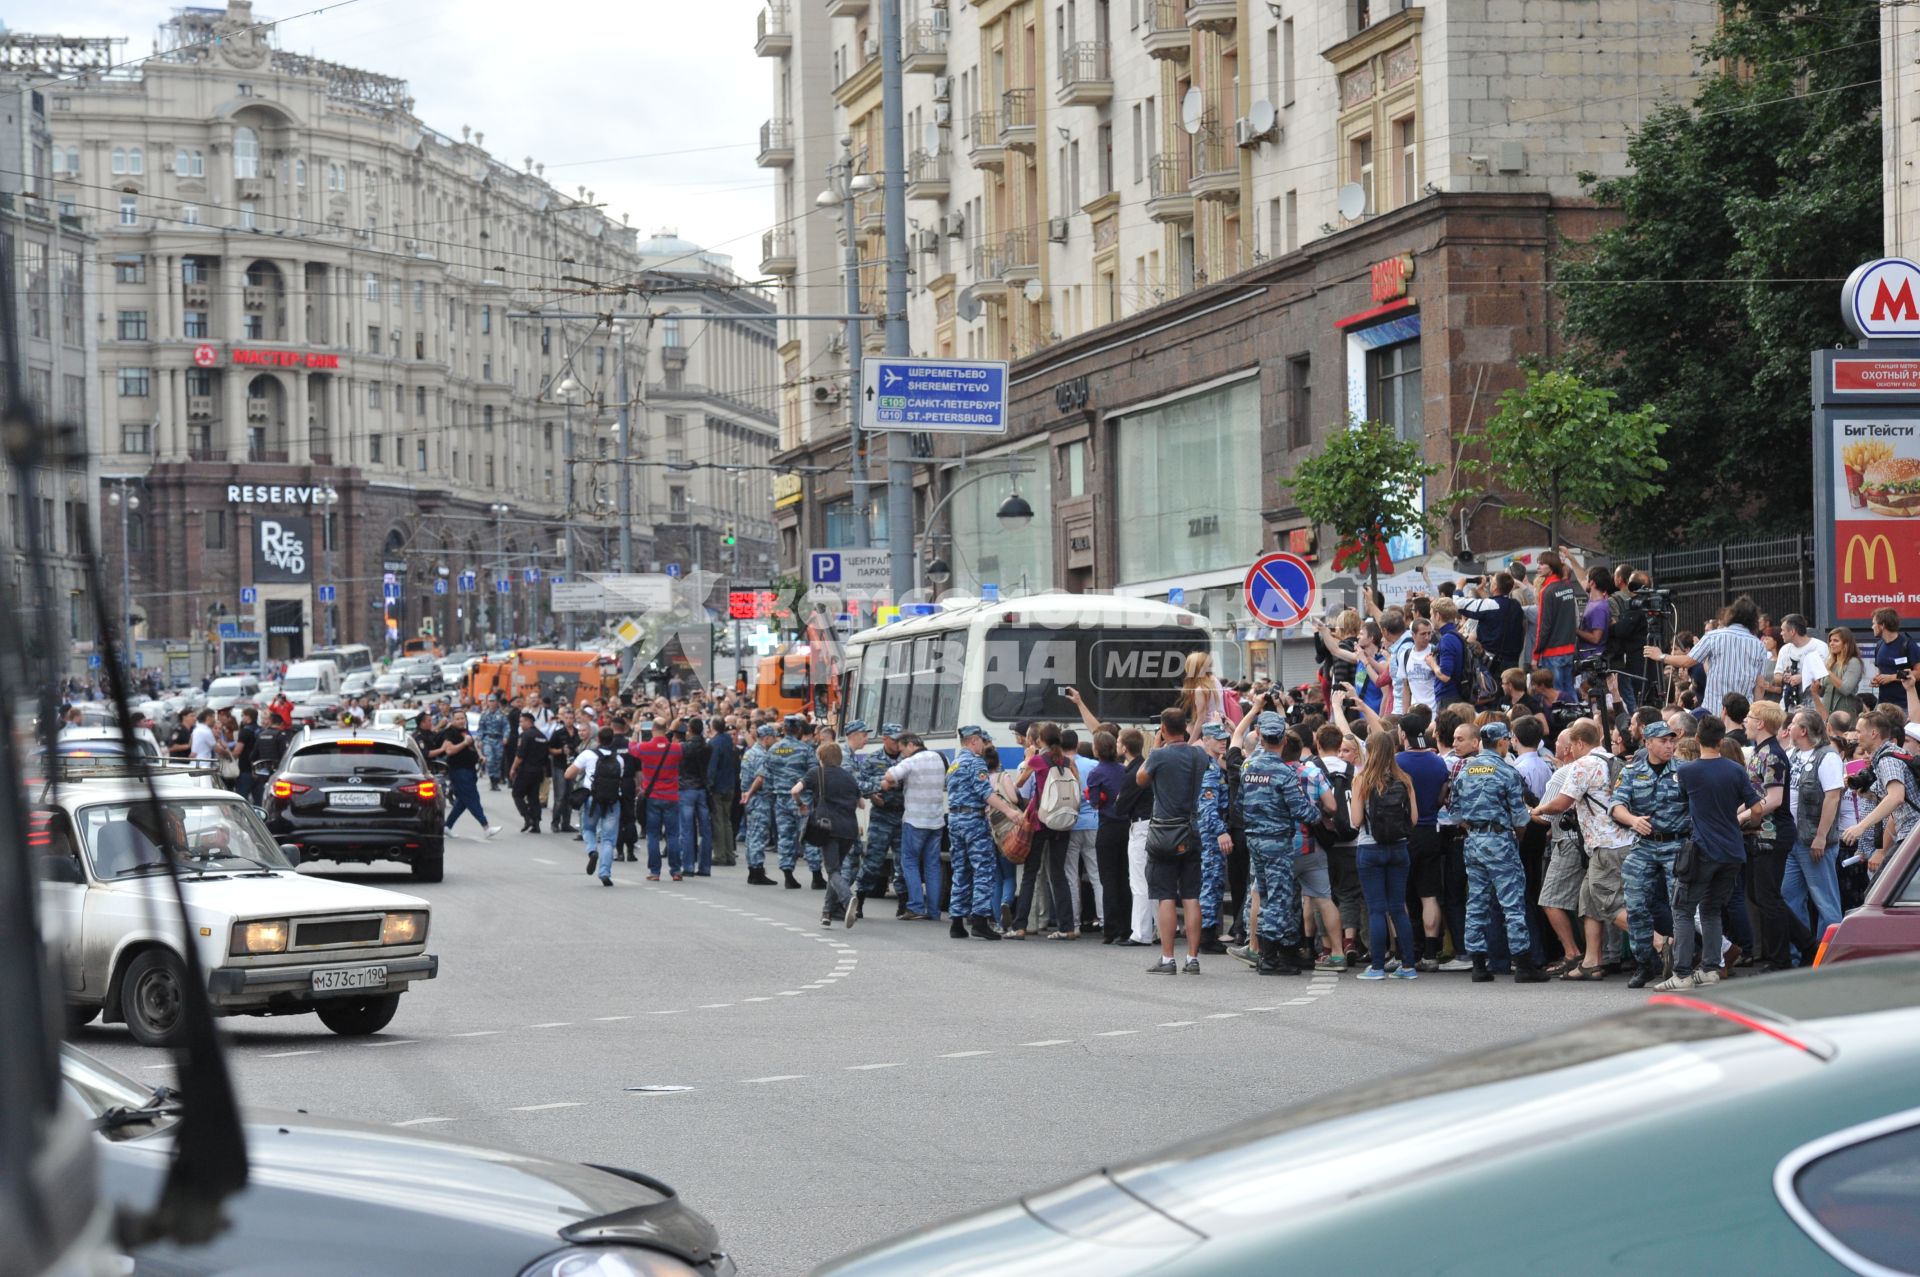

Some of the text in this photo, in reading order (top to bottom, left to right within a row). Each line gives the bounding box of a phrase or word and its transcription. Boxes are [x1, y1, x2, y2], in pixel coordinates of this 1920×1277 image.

[233, 350, 340, 369] МАСТЕР-БАНК
[908, 368, 987, 379] ШЕРЕМЕТЬЕВО
[1861, 369, 1920, 380] ОХОТНЫЙ Р
[908, 382, 990, 393] SHEREMETYEVO
[881, 397, 905, 408] E105
[907, 398, 1002, 410] САНКТ-ПЕТЕРБУРГ
[907, 412, 993, 423] ST.-PETERSBURG
[1844, 423, 1914, 437] БигТейсти
[1844, 591, 1905, 604] Газетный
[1469, 765, 1494, 774] ОМОН
[1244, 774, 1270, 784] ОМОН
[315, 967, 384, 988] М373СТ 190
